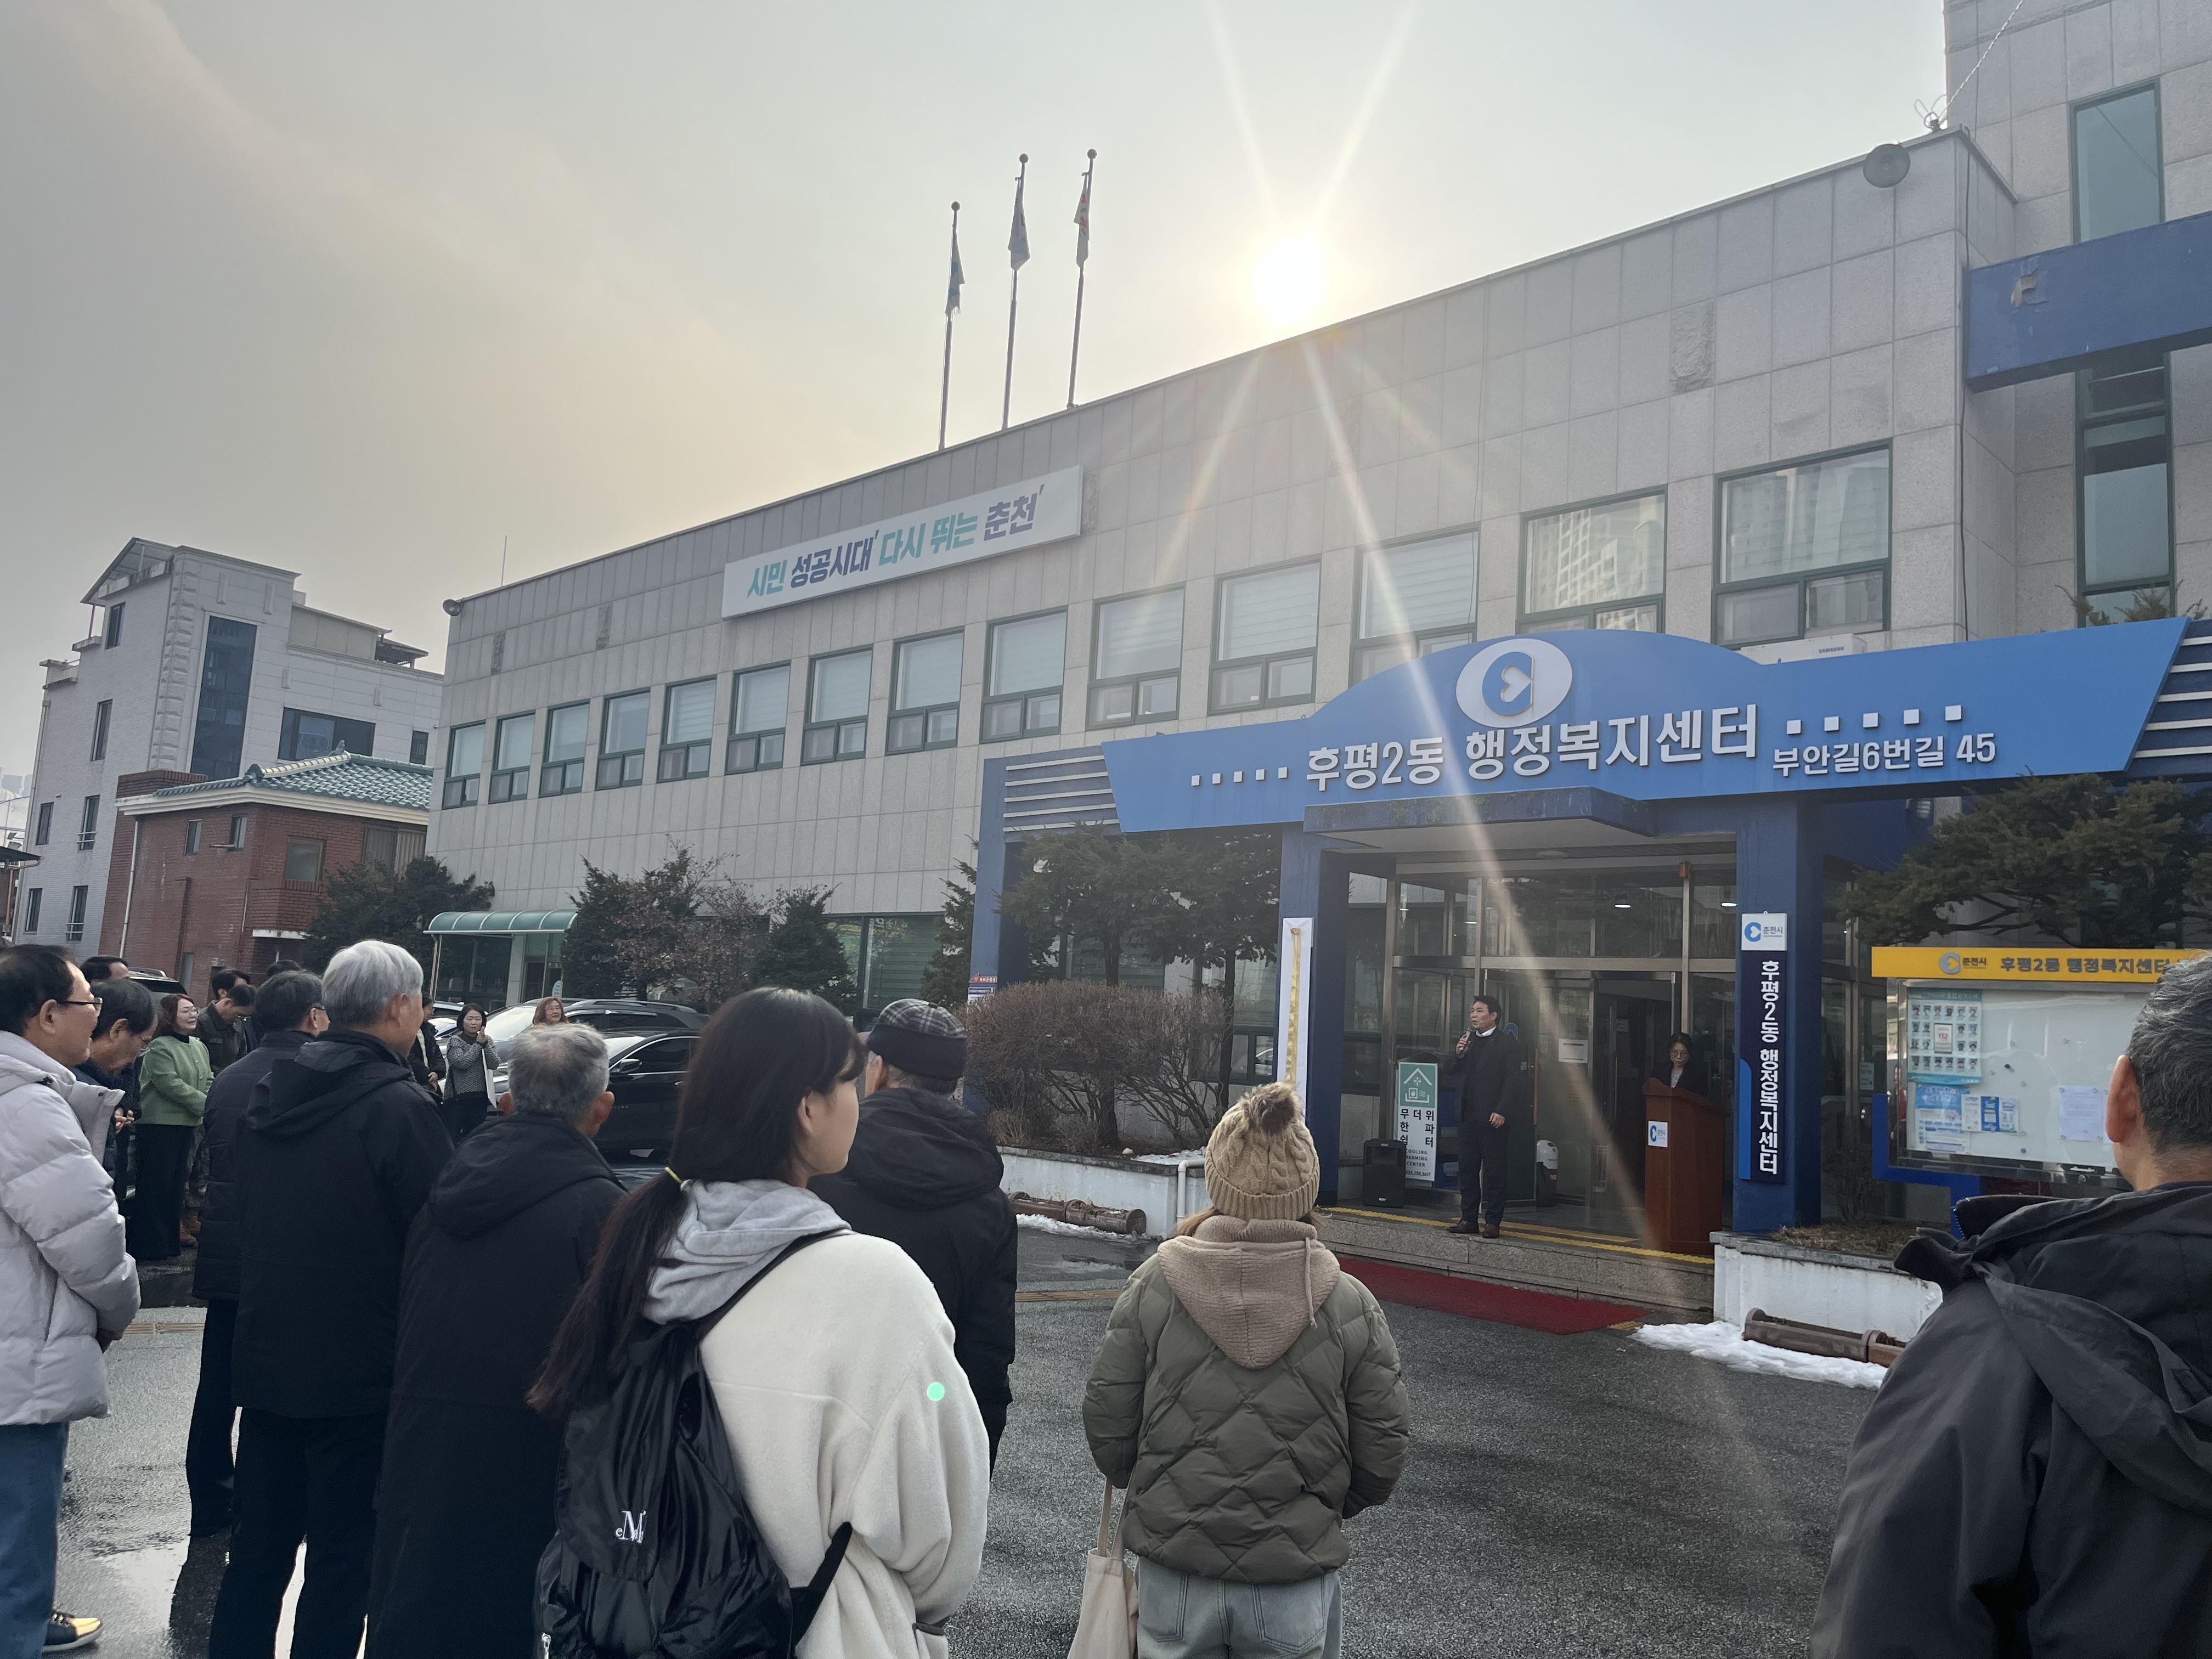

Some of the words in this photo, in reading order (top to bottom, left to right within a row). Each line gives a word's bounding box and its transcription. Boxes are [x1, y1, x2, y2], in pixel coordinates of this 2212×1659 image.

[747, 560, 787, 598] 시민
[878, 523, 926, 566] 다시
[930, 512, 979, 554] 뛰는
[1306, 736, 1443, 792] 후평2동
[1466, 704, 1757, 780] 행정복지센터
[1773, 736, 1944, 777] 부안길6번길
[1956, 732, 1996, 763] 45
[1760, 960, 1779, 1043] 후평2동
[2001, 957, 2061, 972] 후평2동
[1759, 1048, 1779, 1175] 행정복지센터
